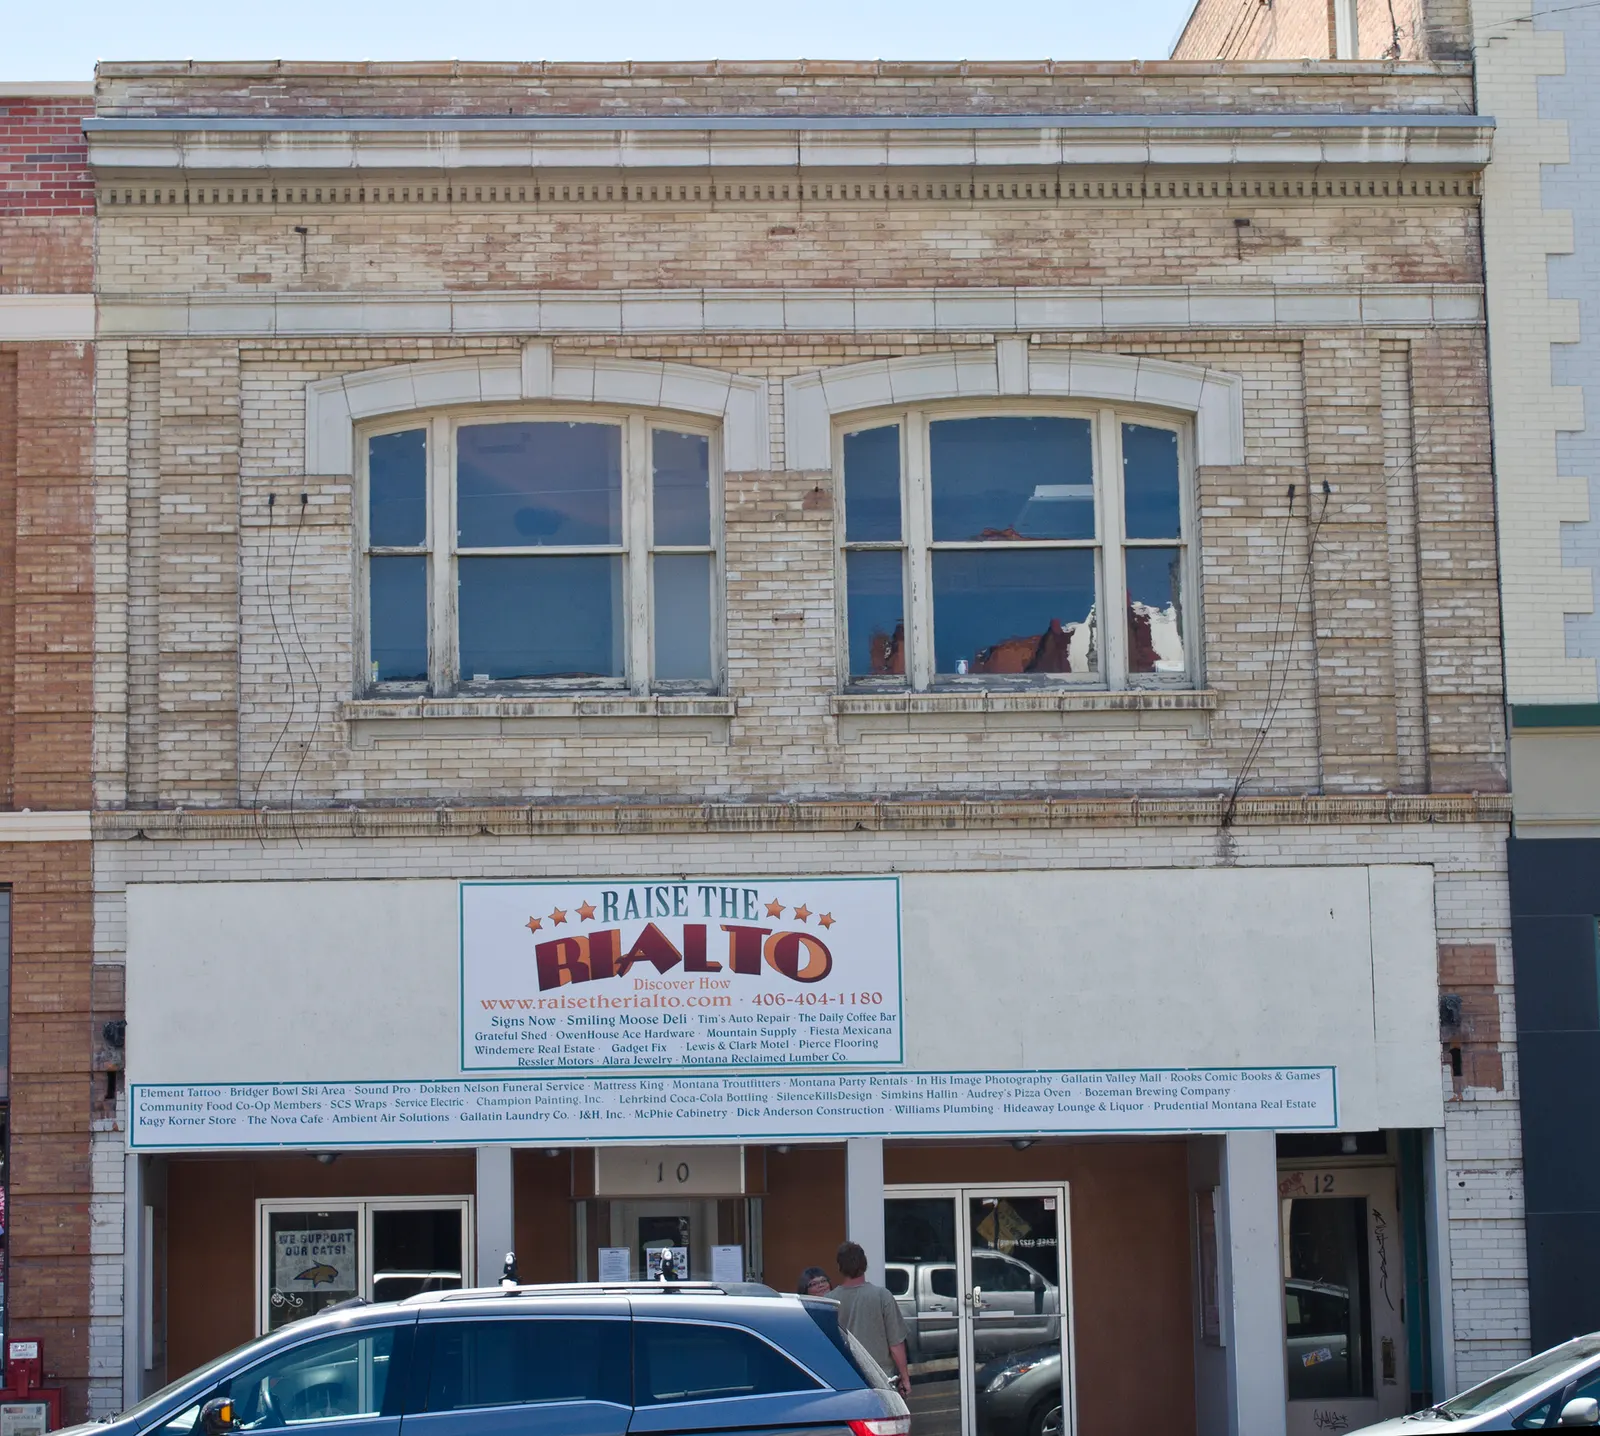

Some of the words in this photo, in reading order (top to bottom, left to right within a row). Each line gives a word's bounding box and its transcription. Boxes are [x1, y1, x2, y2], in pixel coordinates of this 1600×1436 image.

[601, 885, 689, 923] RAISE
[698, 885, 759, 921] THE
[535, 922, 833, 991] RIALTO
[634, 978, 694, 990] Discover
[699, 977, 730, 989] How
[480, 993, 731, 1009] www.raisetherialto.com
[752, 992, 882, 1005] 406-404-1180
[491, 1016, 524, 1028] Signs
[528, 1015, 555, 1025] Now
[567, 1015, 615, 1027] Smiling
[619, 1014, 658, 1024] Moose
[663, 1013, 686, 1024] Deli
[698, 1014, 725, 1023] Tim's
[728, 1014, 753, 1022] Auto
[756, 1013, 790, 1024] Repair
[798, 1013, 816, 1021] The
[819, 1013, 843, 1023] Daily
[846, 1012, 876, 1021] Coffee
[880, 1012, 896, 1021] Bar
[475, 1031, 517, 1040] Grateful
[521, 1031, 546, 1040] Shed
[556, 1030, 619, 1039] OwenHouse
[622, 1030, 640, 1038] Ace
[644, 1029, 694, 1038] Hardware
[707, 1028, 756, 1037] Mountain
[760, 1027, 796, 1040] Supply
[810, 1026, 839, 1035] Fiesta
[843, 1026, 891, 1034] Mexicana
[474, 1045, 534, 1054] Windemere
[538, 1045, 560, 1053] Real
[564, 1044, 594, 1053] Estate
[611, 1043, 647, 1054] Gadget
[652, 1043, 666, 1052] Fix
[686, 1042, 715, 1051] Lewis
[717, 1041, 725, 1050] &
[729, 1041, 756, 1049] Clark
[760, 1040, 788, 1048] Motel
[799, 1040, 830, 1048] Pierce
[834, 1038, 878, 1049] Flooring
[518, 1057, 554, 1067] Ressler
[558, 1056, 593, 1066] Motors
[602, 1056, 629, 1066] Alara
[633, 1055, 672, 1068] Jewelry
[681, 1054, 729, 1065] Montana
[731, 1053, 785, 1064] Reclaimed
[788, 1052, 829, 1063] Lumber
[831, 1052, 848, 1063] Co.
[140, 1086, 183, 1097] Element
[187, 1085, 220, 1097] Tattoo
[230, 1085, 268, 1098] Bridger
[272, 1084, 297, 1095] Bowl
[301, 1084, 317, 1095] Ski
[321, 1084, 345, 1095] Area
[354, 1083, 388, 1094] Sound
[392, 1083, 410, 1093] Pro
[420, 1082, 459, 1093] Dokken
[464, 1084, 498, 1092] Nelson
[503, 1083, 542, 1091] Funeral
[546, 1082, 584, 1091] Service
[594, 1081, 636, 1090] Mattress
[640, 1080, 663, 1090] King
[672, 1080, 718, 1088] Montana
[722, 1079, 780, 1088] Troutfitters
[789, 1078, 835, 1087] Montana
[839, 1077, 866, 1087] Party
[869, 1076, 907, 1085] Rentals
[917, 1076, 926, 1084] In
[931, 1076, 946, 1084] His
[950, 1076, 981, 1086] Image
[985, 1075, 1052, 1085] Photography
[1061, 1074, 1102, 1083] Gallatin
[1105, 1074, 1136, 1084] Valley
[1139, 1073, 1161, 1082] Mall
[1171, 1073, 1202, 1081] Rooks
[1204, 1072, 1237, 1081] Comic
[1241, 1072, 1272, 1080] Books
[1274, 1071, 1282, 1080] &
[1285, 1071, 1320, 1080] Games
[140, 1102, 203, 1112] Community
[206, 1101, 232, 1110] Food
[235, 1100, 270, 1111] Co-Op
[274, 1100, 321, 1109] Members
[330, 1099, 351, 1108] SCS
[354, 1099, 387, 1109] Wraps
[395, 1098, 427, 1107] Service
[430, 1097, 463, 1106] Electric
[476, 1097, 531, 1107] Champion
[585, 1095, 603, 1103] Inc.
[619, 1094, 666, 1103] Lehrkind
[670, 1093, 722, 1103] Coca-Cola
[726, 1093, 767, 1103] Bottling
[776, 1091, 871, 1101] SilenceKillsDesign
[881, 1090, 923, 1099] Simkins
[927, 1089, 957, 1098] Hallin
[967, 1089, 1011, 1099] Audrey's
[1015, 1088, 1040, 1097] Pizza
[1043, 1088, 1070, 1097] Oven
[1085, 1087, 1132, 1096] Bozeman
[1135, 1087, 1177, 1097] Brewing
[1180, 1086, 1230, 1097] Company
[139, 1116, 165, 1127] Kagy
[168, 1116, 205, 1125] Korner
[208, 1116, 236, 1124] Store
[247, 1115, 266, 1124] The
[271, 1115, 296, 1124] Nova
[300, 1114, 323, 1123] Cafe
[332, 1114, 376, 1122] Ambient
[380, 1113, 396, 1122] Air
[399, 1113, 449, 1122] Solutions
[460, 1112, 502, 1121] Gallatin
[506, 1111, 549, 1121] Laundry
[553, 1110, 568, 1119] Co.
[606, 1110, 625, 1118] Inc.
[634, 1109, 673, 1118] McPhie
[676, 1108, 727, 1119] Cabinetry
[737, 1107, 760, 1116] Dick
[763, 1107, 812, 1115] Anderson
[816, 1105, 883, 1115] Construction
[894, 1105, 940, 1113] Williams
[943, 1104, 993, 1114] Plumbing
[1003, 1103, 1054, 1113] Hideaway
[1058, 1103, 1095, 1113] Lounge
[1098, 1102, 1106, 1111] &
[1110, 1102, 1143, 1112] Liquor
[1154, 1101, 1208, 1110] Prudential
[1212, 1100, 1256, 1109] Montana
[1261, 1099, 1282, 1108] Real
[1286, 1099, 1316, 1108] Estate
[1314, 1174, 1334, 1193] 12
[279, 1234, 295, 1244] WE
[301, 1233, 352, 1243] SUPPORT
[285, 1247, 308, 1256] OUR
[312, 1245, 346, 1255] CATS!
